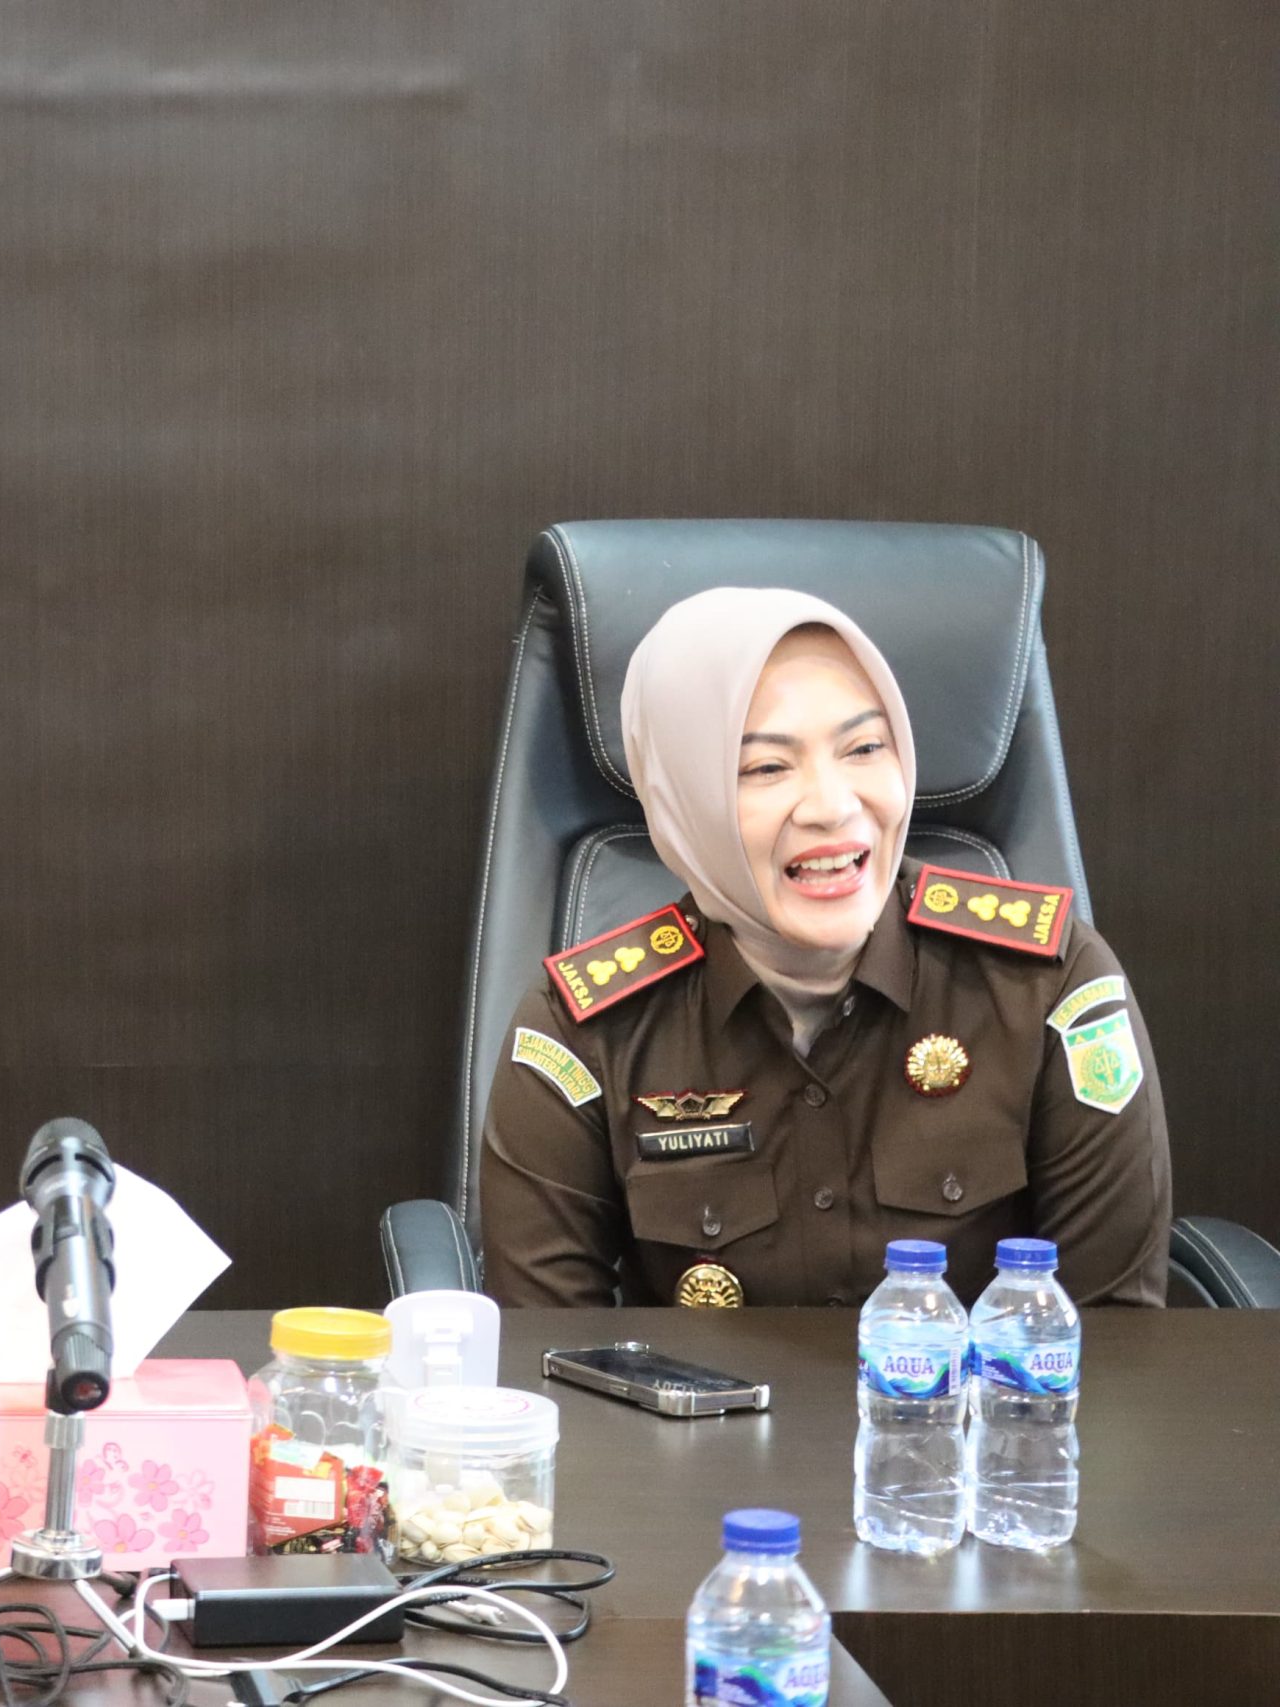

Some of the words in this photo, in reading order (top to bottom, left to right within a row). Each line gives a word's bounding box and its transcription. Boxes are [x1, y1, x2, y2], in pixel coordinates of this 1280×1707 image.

[1032, 894, 1061, 946] JAKSA
[558, 961, 594, 1010] JAKSA
[658, 1131, 729, 1152] YULIYATI
[883, 1355, 935, 1377] AQUA
[1030, 1351, 1073, 1374] AQUA
